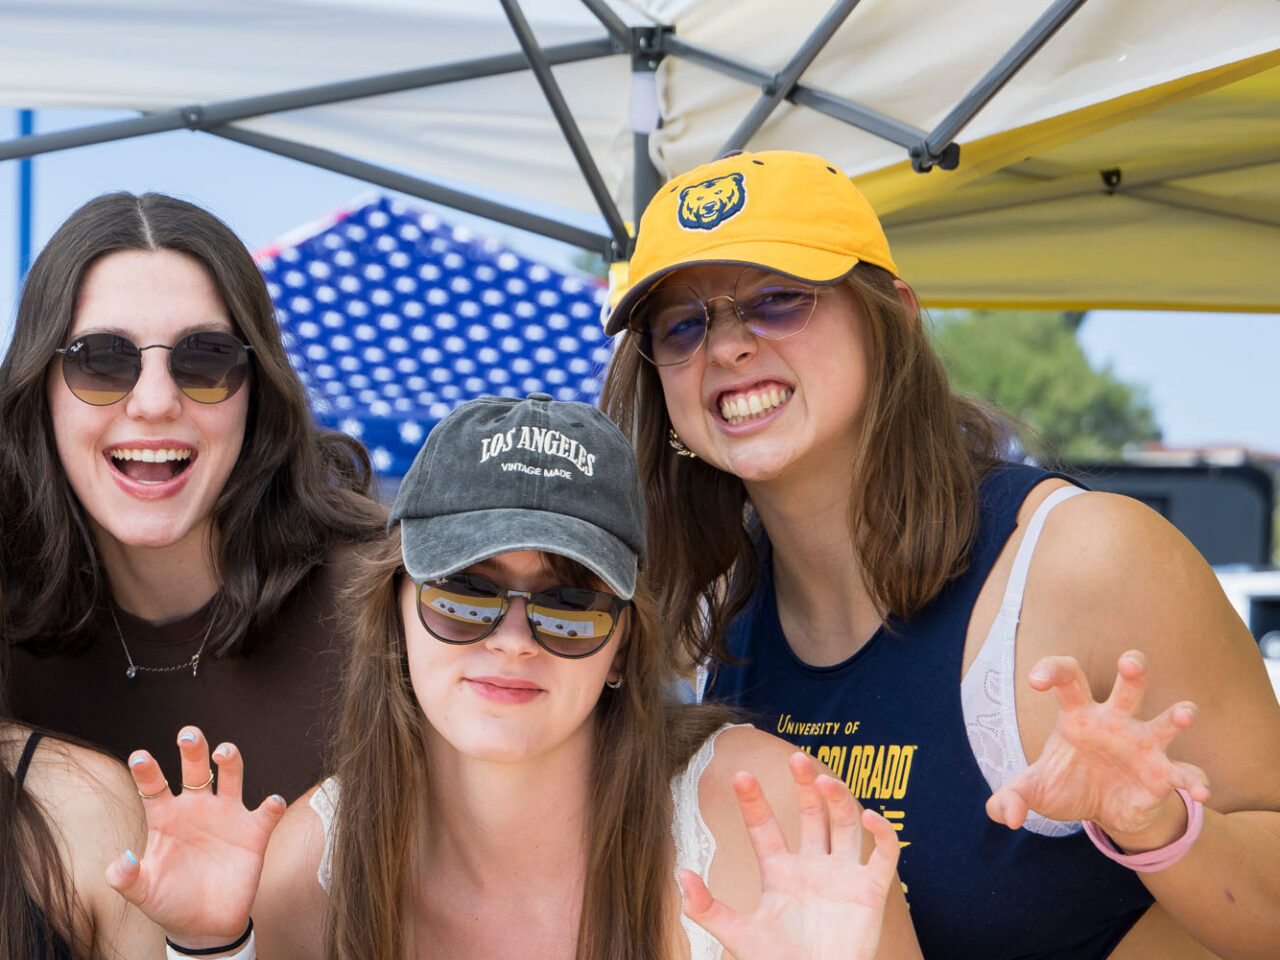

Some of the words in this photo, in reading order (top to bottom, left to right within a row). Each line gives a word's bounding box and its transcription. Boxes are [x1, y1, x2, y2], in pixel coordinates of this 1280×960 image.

[479, 427, 516, 463] LOS
[517, 426, 596, 476] ANGELES
[501, 463, 542, 475] VINTAGE
[543, 468, 572, 480] MADE
[844, 721, 860, 735] OF
